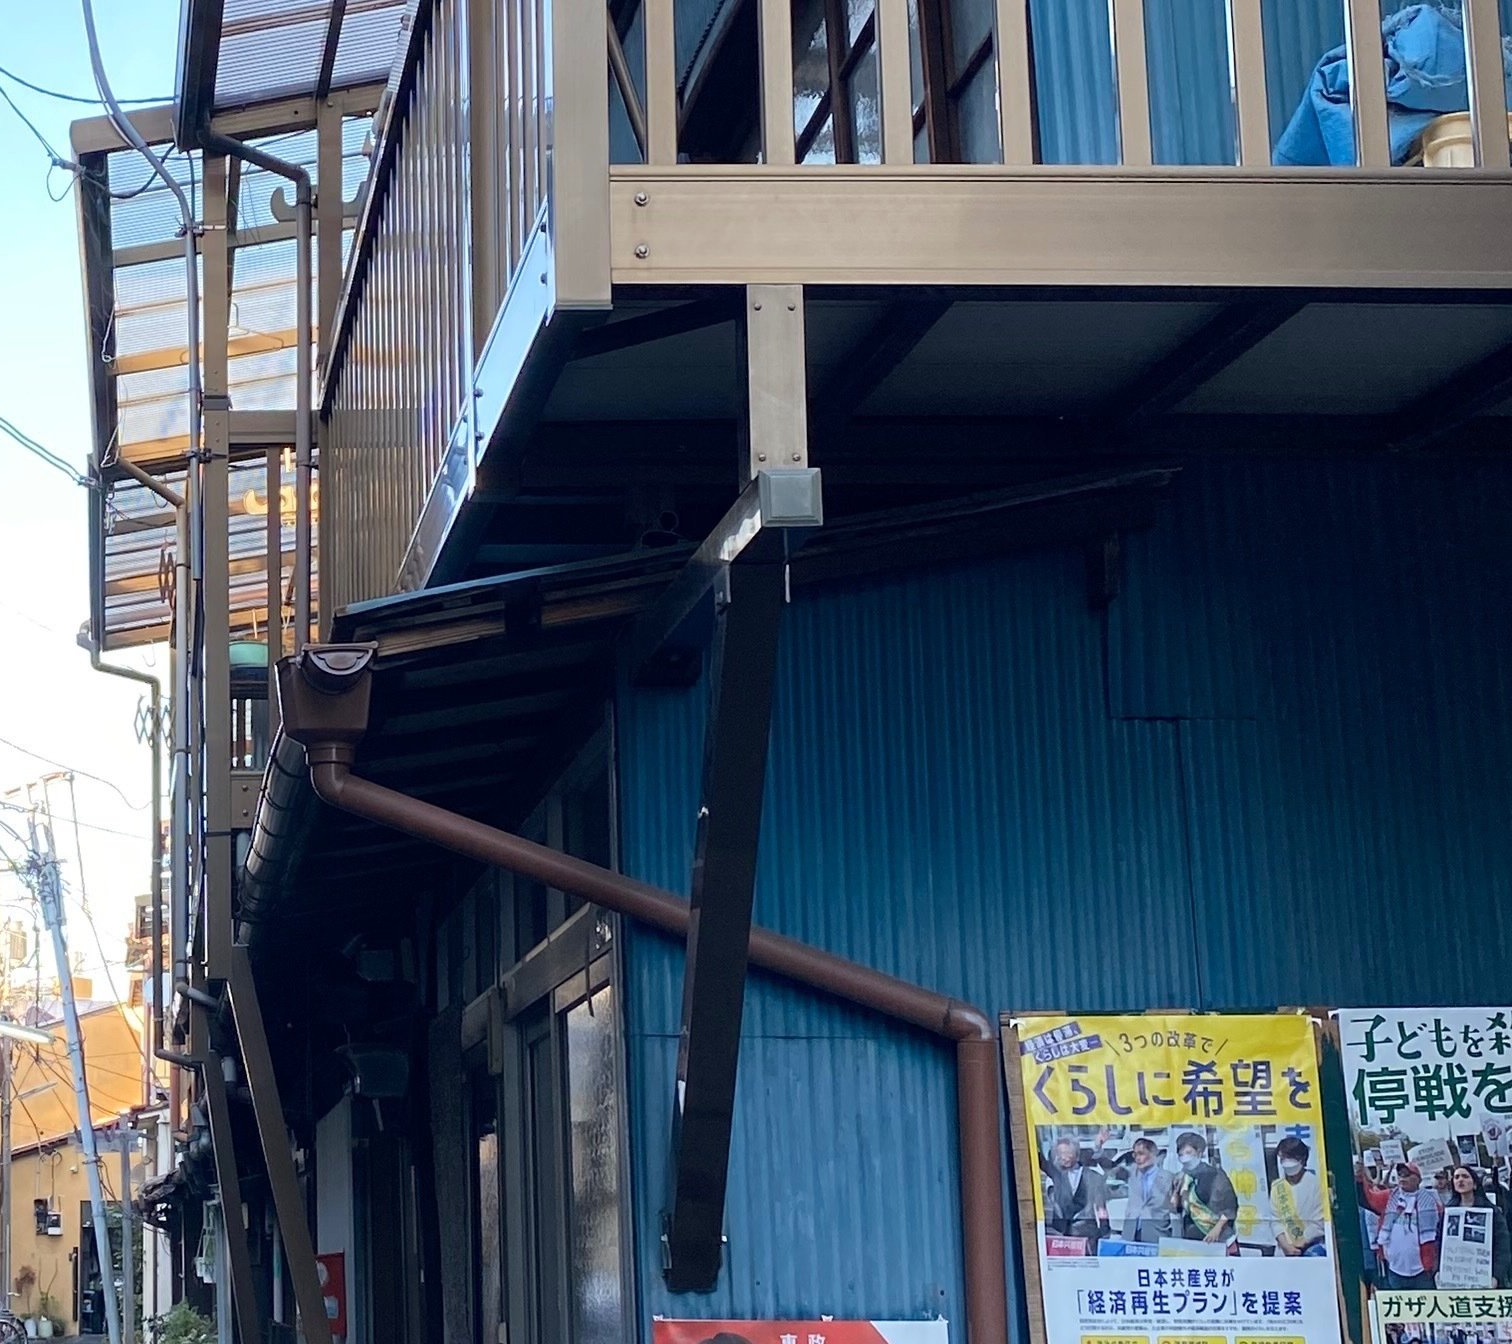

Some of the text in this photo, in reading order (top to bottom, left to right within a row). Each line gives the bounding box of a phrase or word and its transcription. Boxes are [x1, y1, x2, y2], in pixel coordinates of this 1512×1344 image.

[1119, 1030, 1214, 1054] 3つの改革で
[1033, 1058, 1312, 1118] くらしに希望を
[1353, 1063, 1512, 1125] 停戦を
[1137, 1268, 1235, 1288] 日本共産党が
[1076, 1290, 1303, 1316] 「経済再生プラン」を提案
